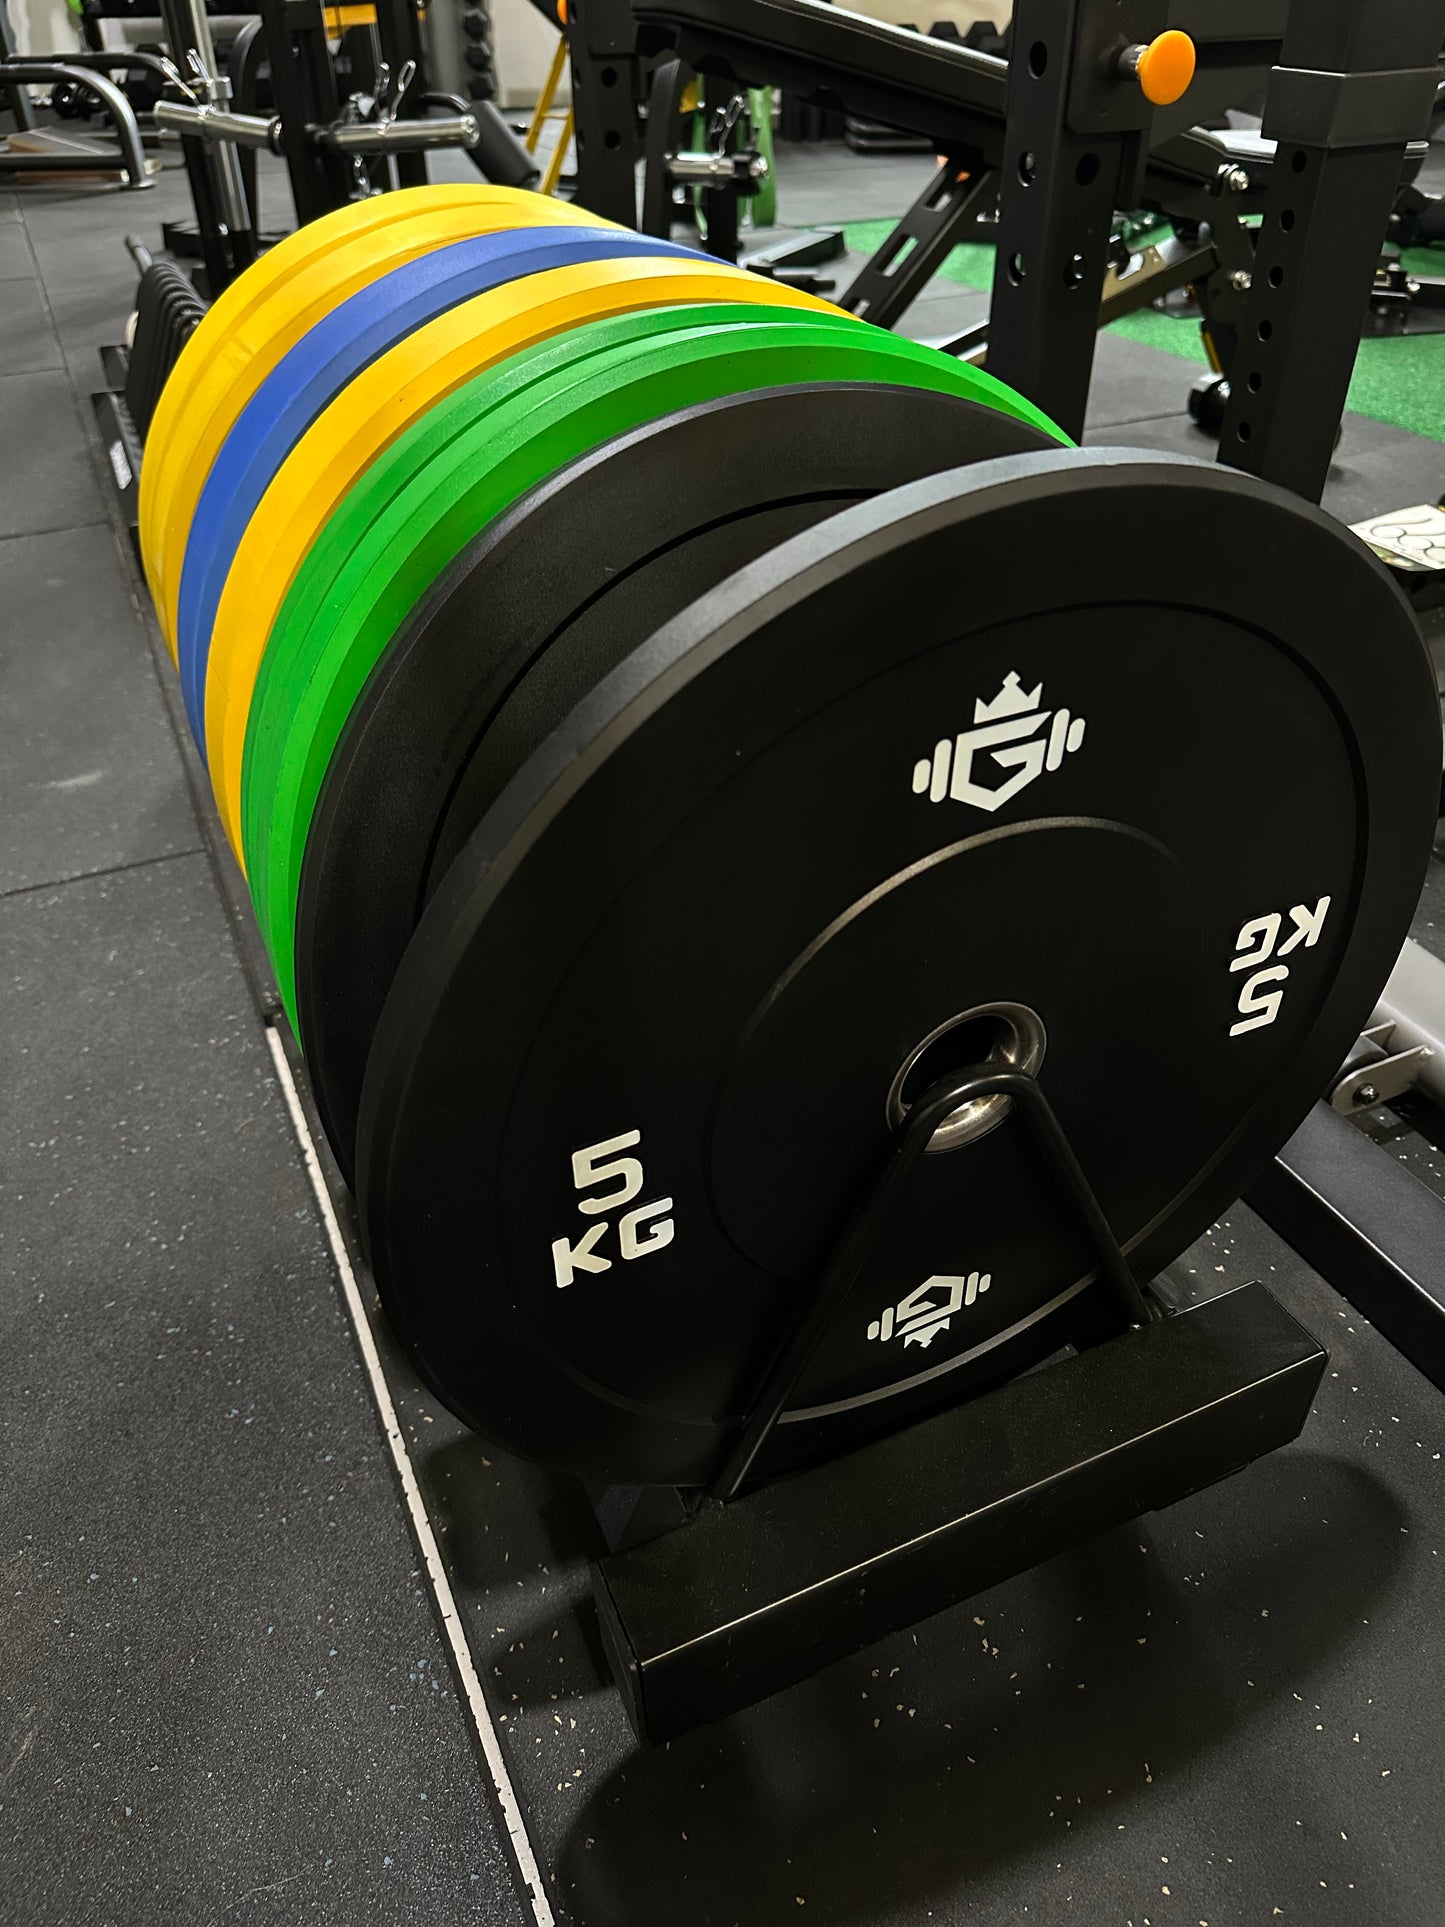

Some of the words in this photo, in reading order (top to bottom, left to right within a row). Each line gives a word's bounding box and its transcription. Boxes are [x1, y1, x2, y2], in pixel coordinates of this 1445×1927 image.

[1229, 895, 1331, 973] KG
[1229, 964, 1290, 1037] 5
[571, 1129, 644, 1215] 5
[551, 1196, 675, 1289] KG
